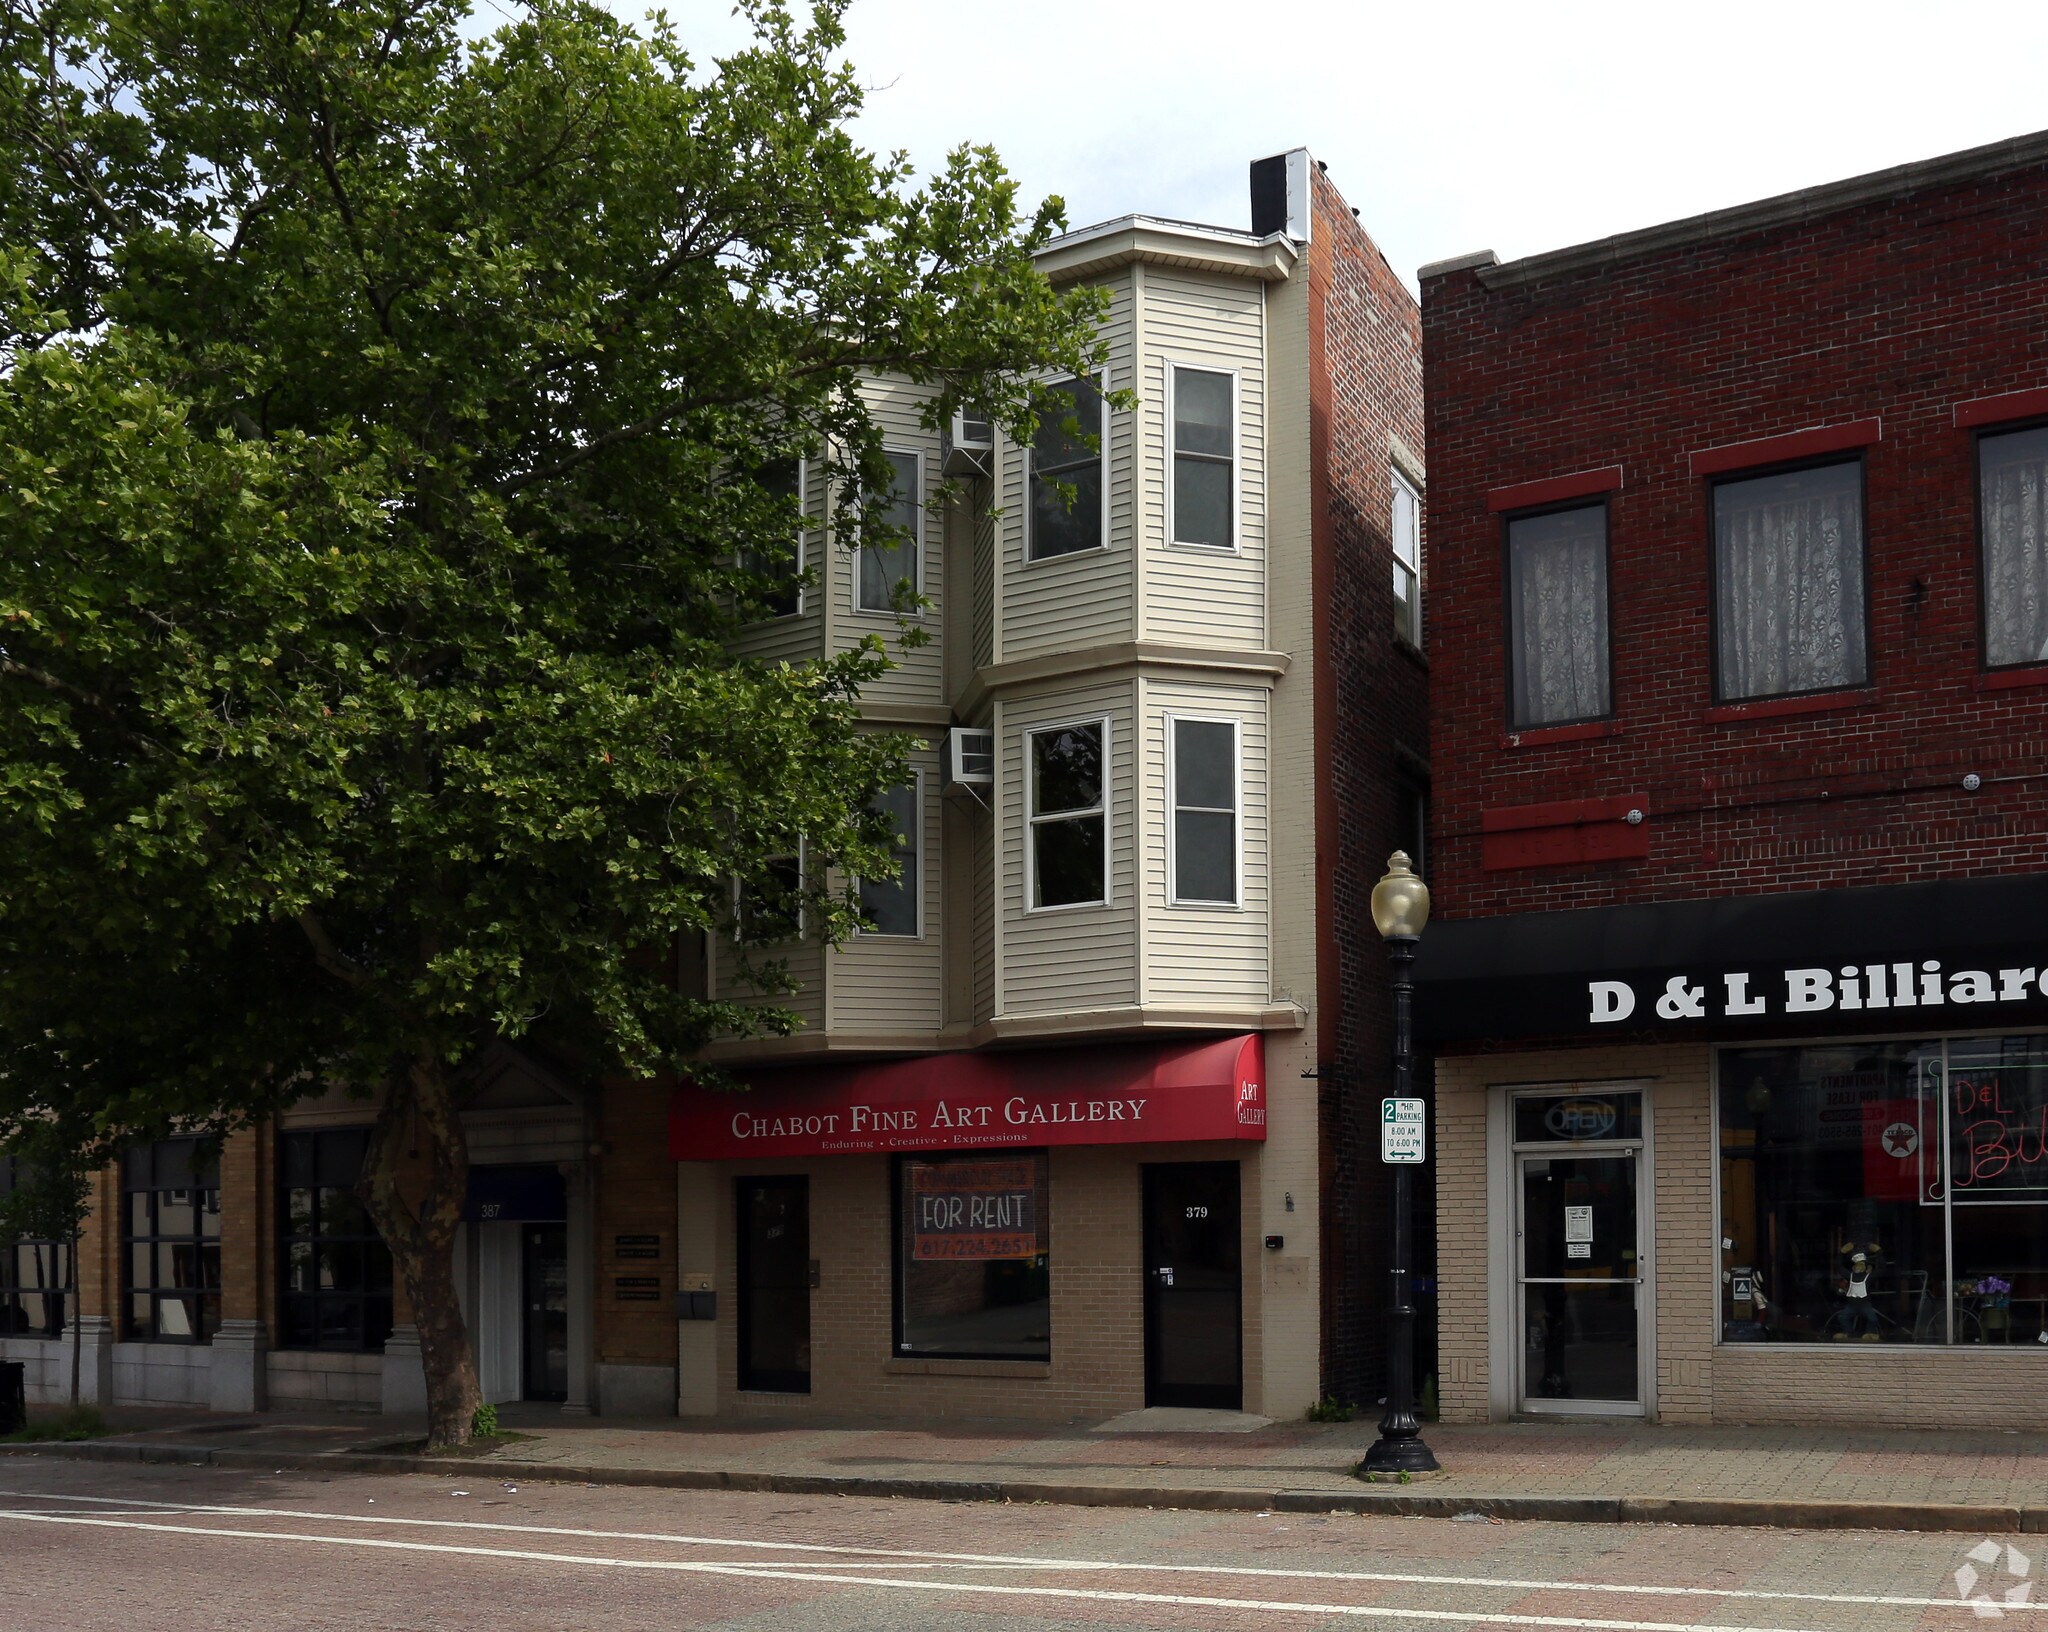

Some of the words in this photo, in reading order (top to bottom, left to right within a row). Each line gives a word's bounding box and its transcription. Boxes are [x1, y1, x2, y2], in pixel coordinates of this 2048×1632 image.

[1588, 980, 1635, 1023] D
[1655, 976, 1706, 1020] &
[1723, 972, 1766, 1016] L
[1784, 959, 2048, 1013] Billiar
[1241, 1080, 1258, 1101] ART
[731, 1112, 840, 1139] CHABOT
[849, 1105, 918, 1132] FINE
[930, 1100, 993, 1128] ART
[1004, 1096, 1147, 1125] GALLERY
[1237, 1101, 1265, 1125] GALLERY
[1385, 1103, 1395, 1120] 2
[1403, 1102, 1414, 1111] HR
[1396, 1112, 1421, 1121] PARKING
[1550, 1106, 1609, 1130] OPEN
[1407, 1127, 1416, 1135] AM
[822, 1139, 874, 1150] Enduring
[889, 1136, 937, 1147] Creative
[953, 1133, 1028, 1144] Expressions
[1387, 1138, 1394, 1147] TO
[1412, 1138, 1420, 1147] PM
[481, 1204, 501, 1218] 387
[923, 1195, 963, 1229] FOR
[970, 1194, 1027, 1229] RENT
[1186, 1206, 1208, 1218] 379
